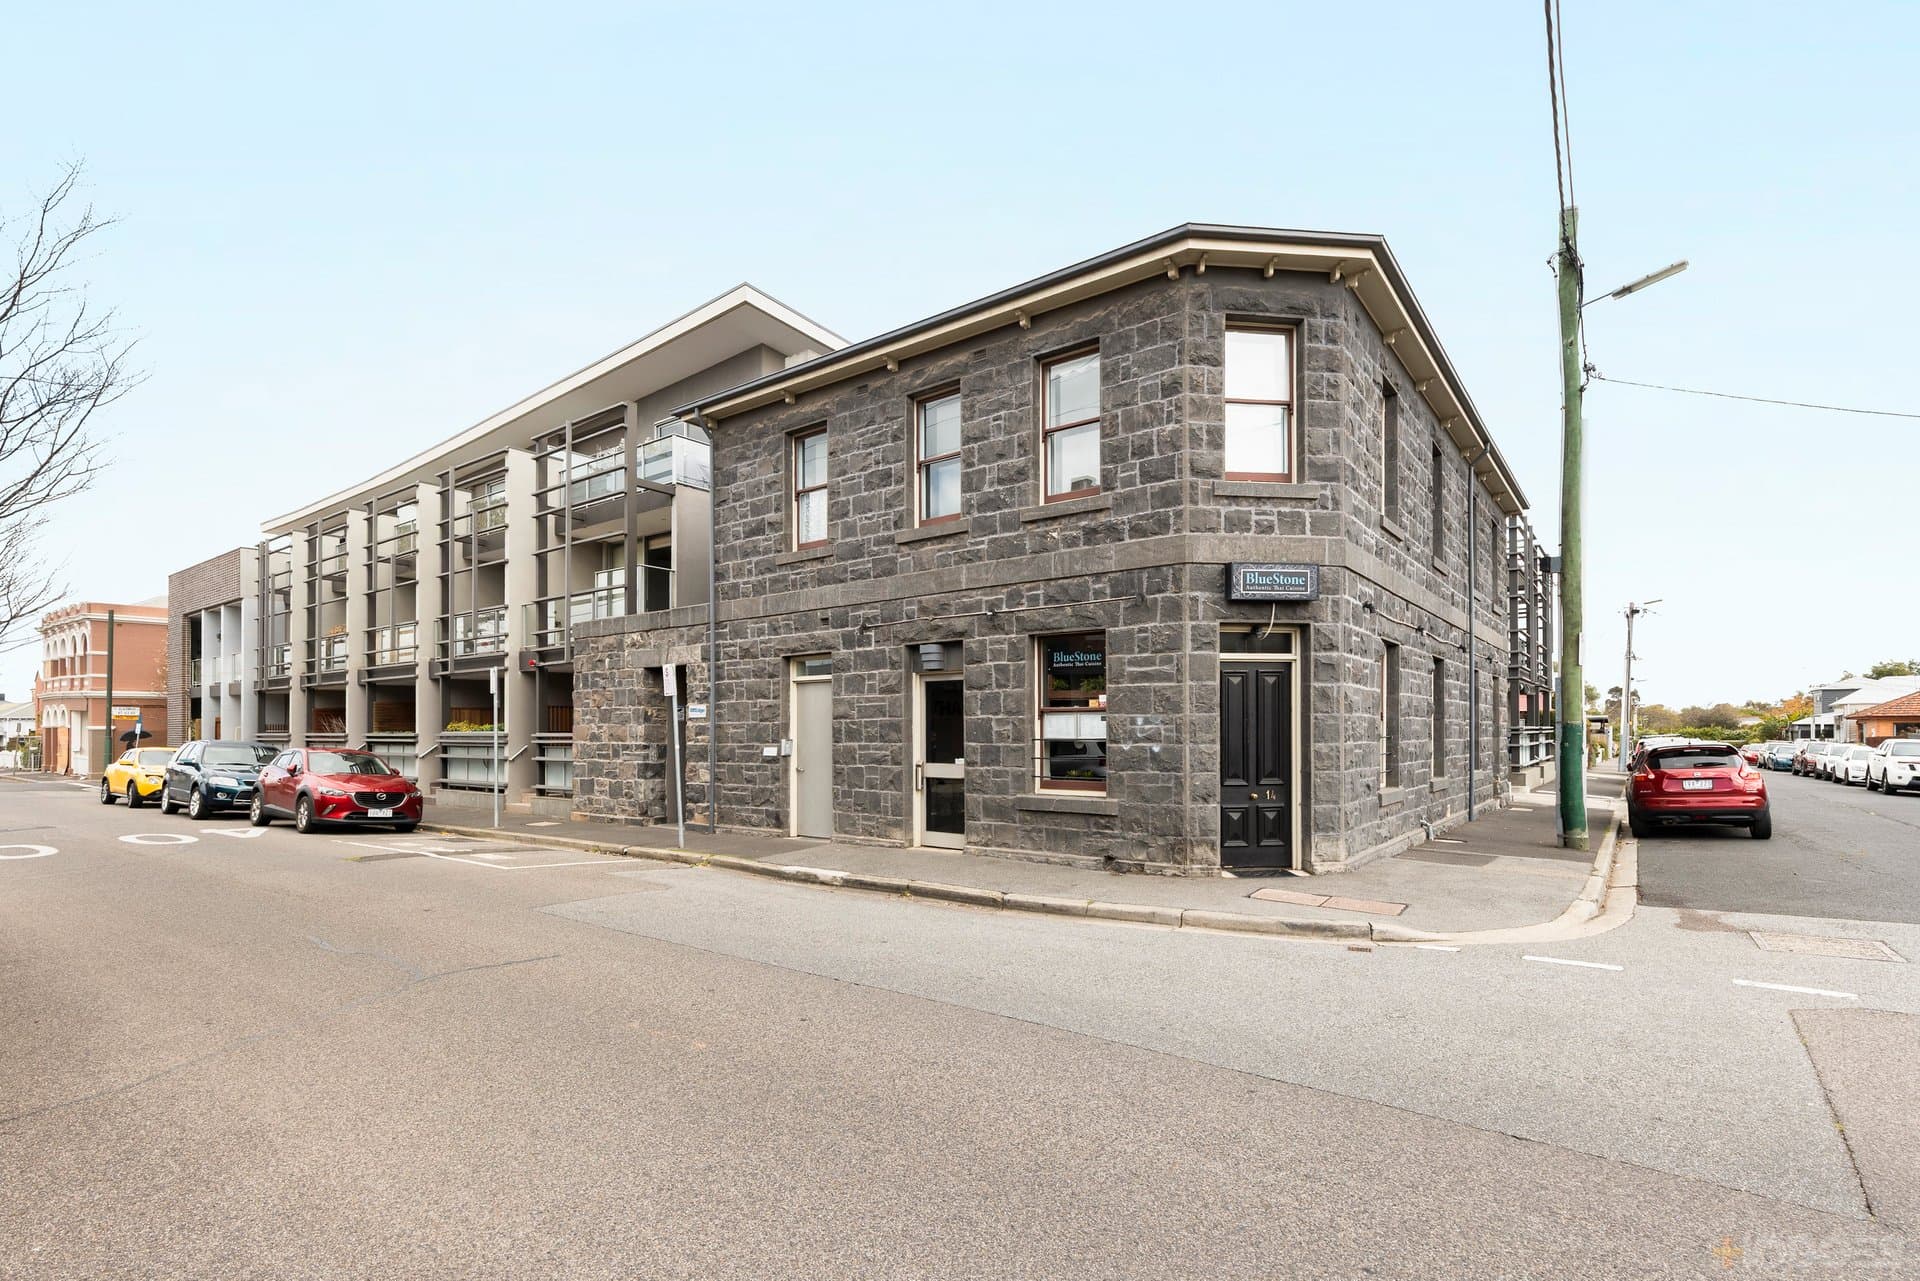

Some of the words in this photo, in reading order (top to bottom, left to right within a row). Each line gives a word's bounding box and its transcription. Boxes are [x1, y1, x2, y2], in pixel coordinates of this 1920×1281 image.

[1245, 572, 1306, 585] BlueStone
[1053, 651, 1103, 662] BlueStone
[1265, 789, 1276, 801] 14
